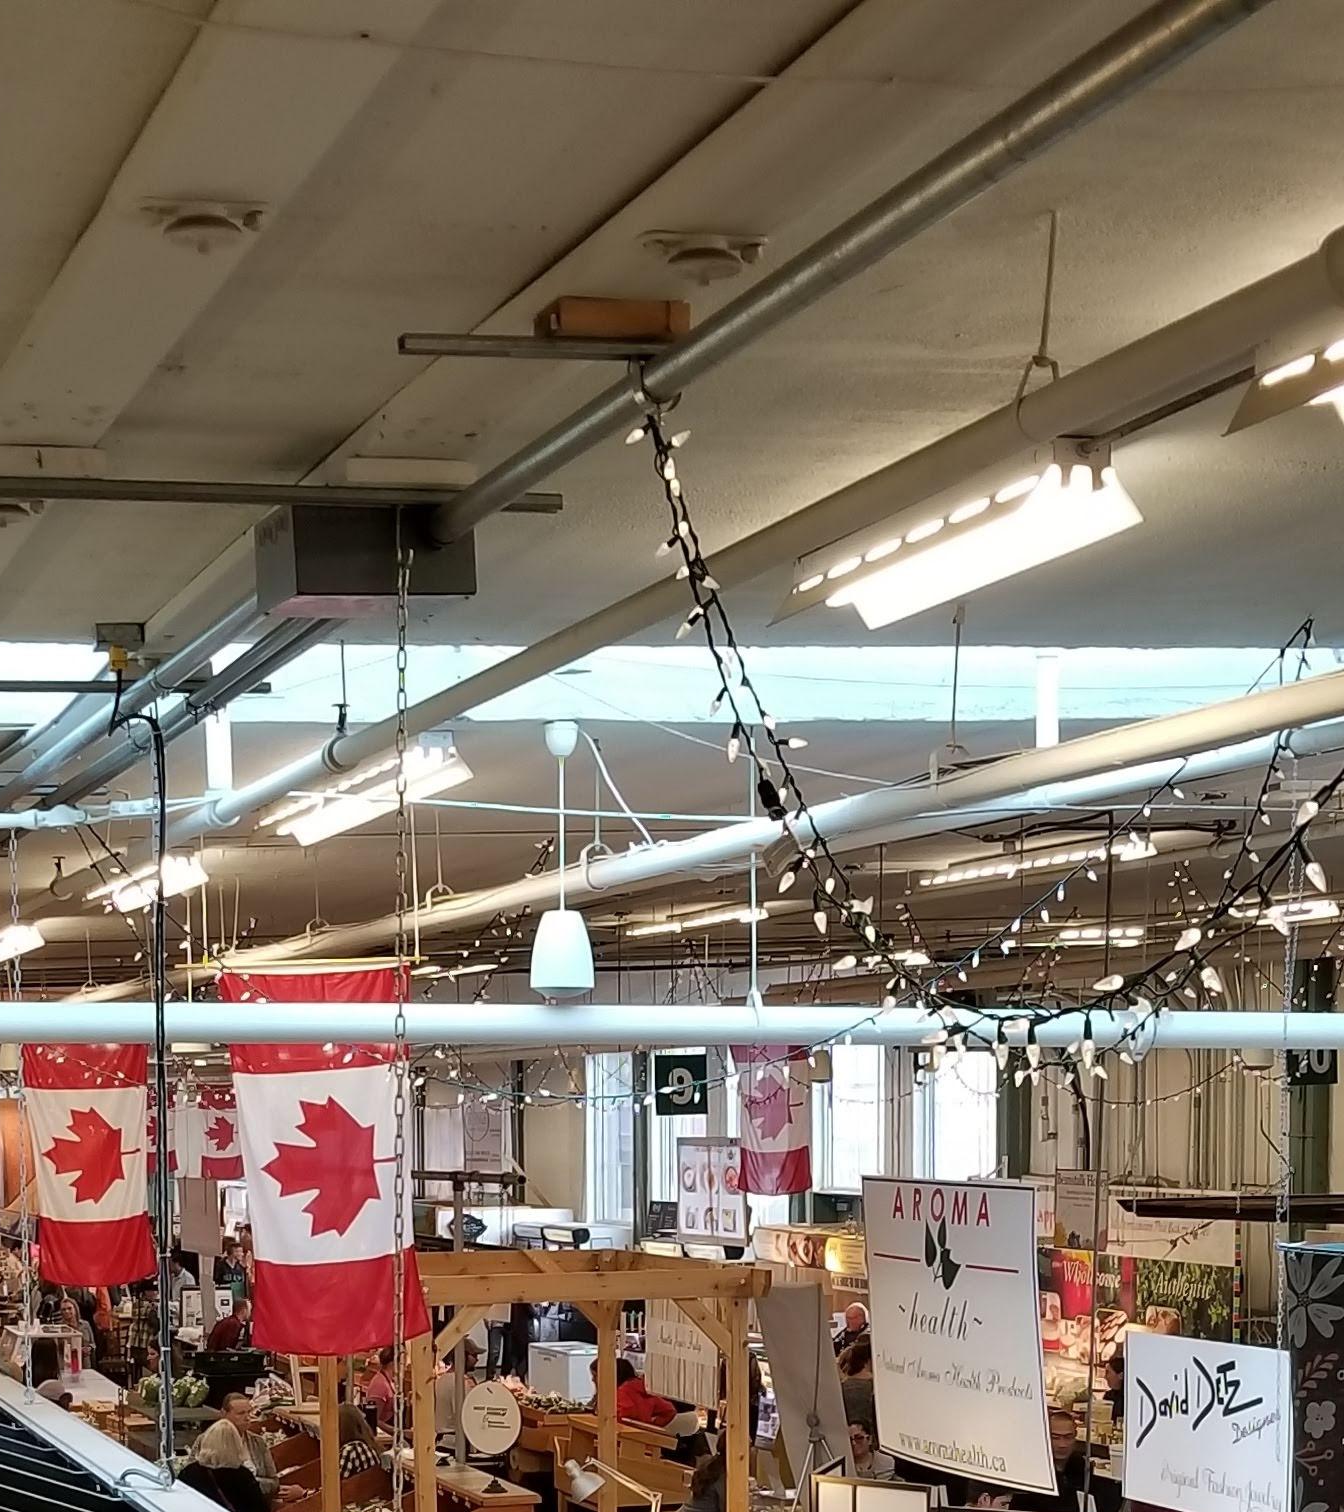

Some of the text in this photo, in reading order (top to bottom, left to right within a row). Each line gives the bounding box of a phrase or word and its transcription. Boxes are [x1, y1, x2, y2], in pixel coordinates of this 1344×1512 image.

[668, 1067, 694, 1106] 9
[892, 1186, 990, 1227] AROMA
[1155, 1271, 1213, 1300] Authentic
